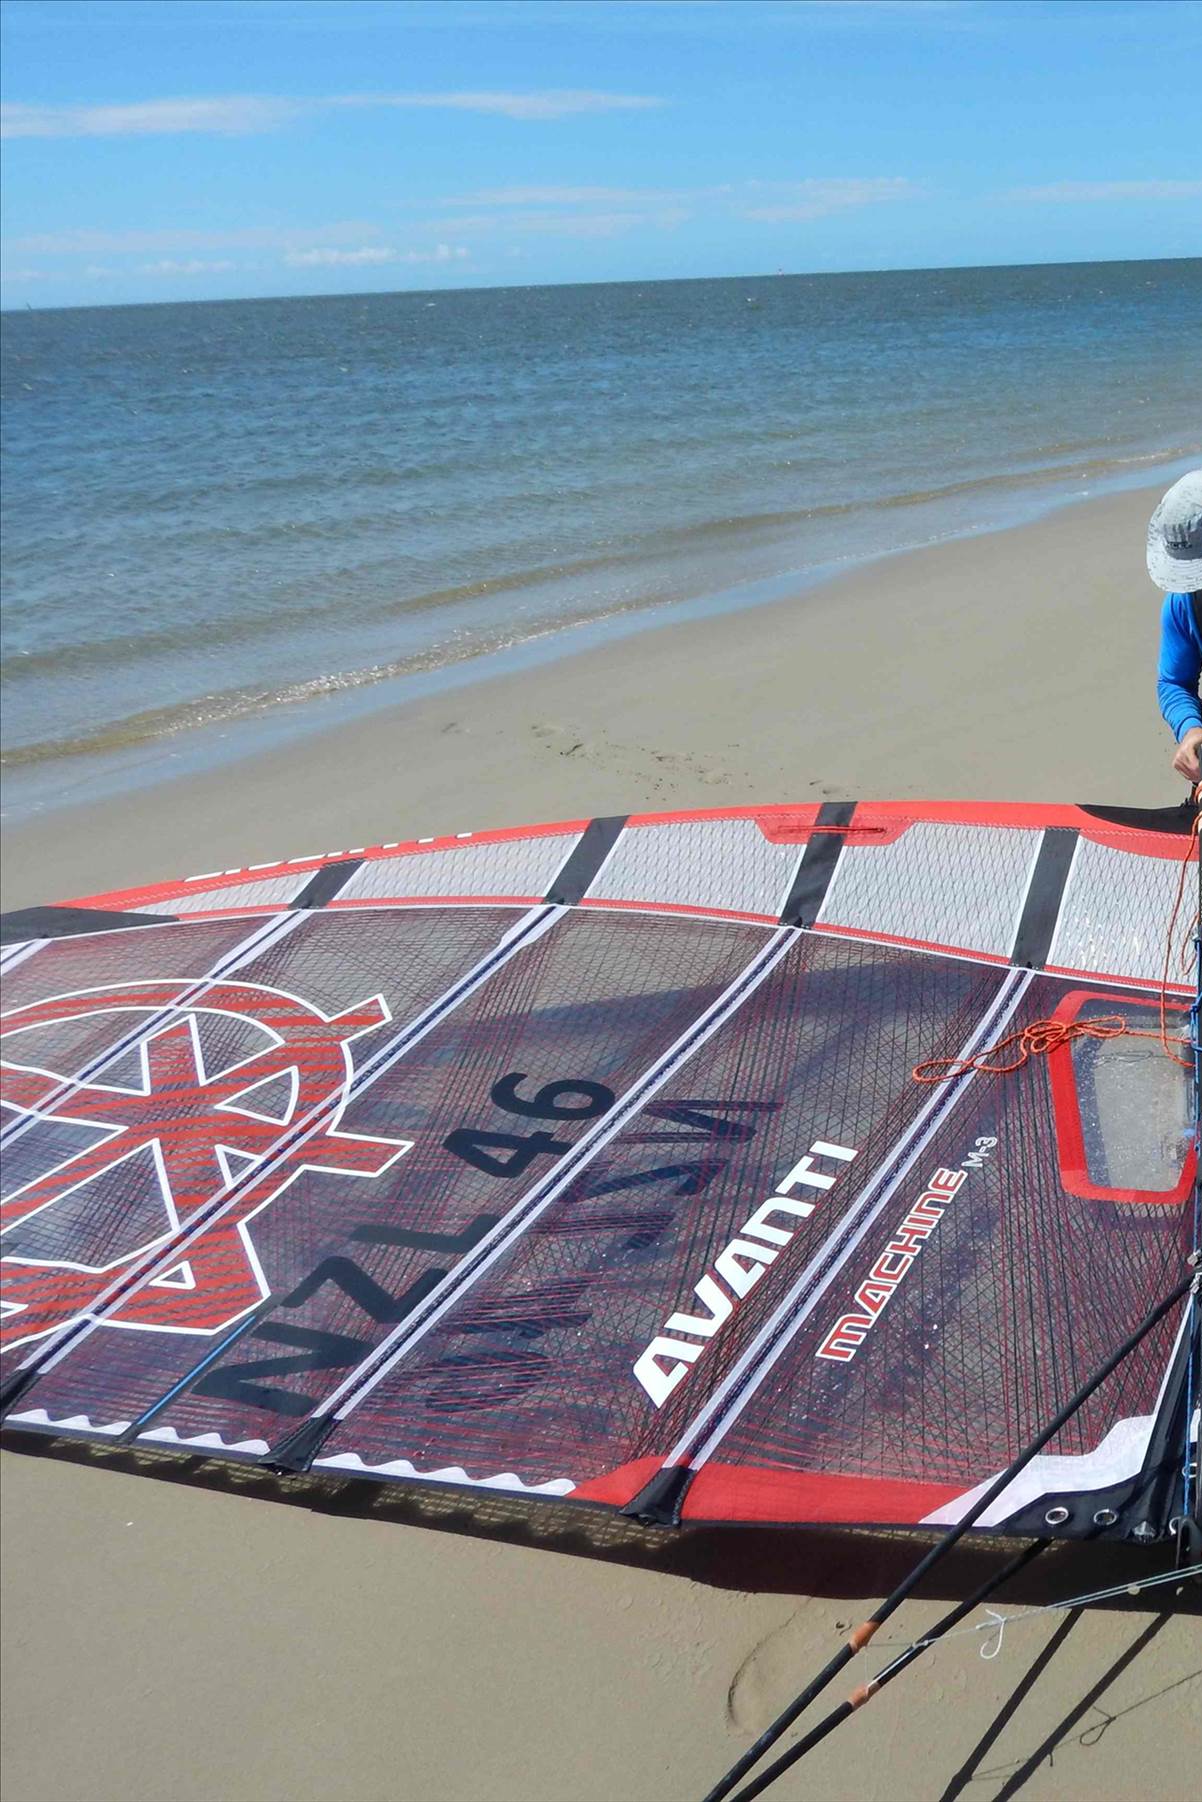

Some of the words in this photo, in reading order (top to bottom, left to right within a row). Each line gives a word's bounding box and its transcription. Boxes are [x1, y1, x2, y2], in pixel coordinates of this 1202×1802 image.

[191, 1213, 502, 1418] NZL
[443, 1072, 616, 1178] 46
[633, 1140, 859, 1409] AVANTI
[815, 1168, 968, 1362] MACHINE
